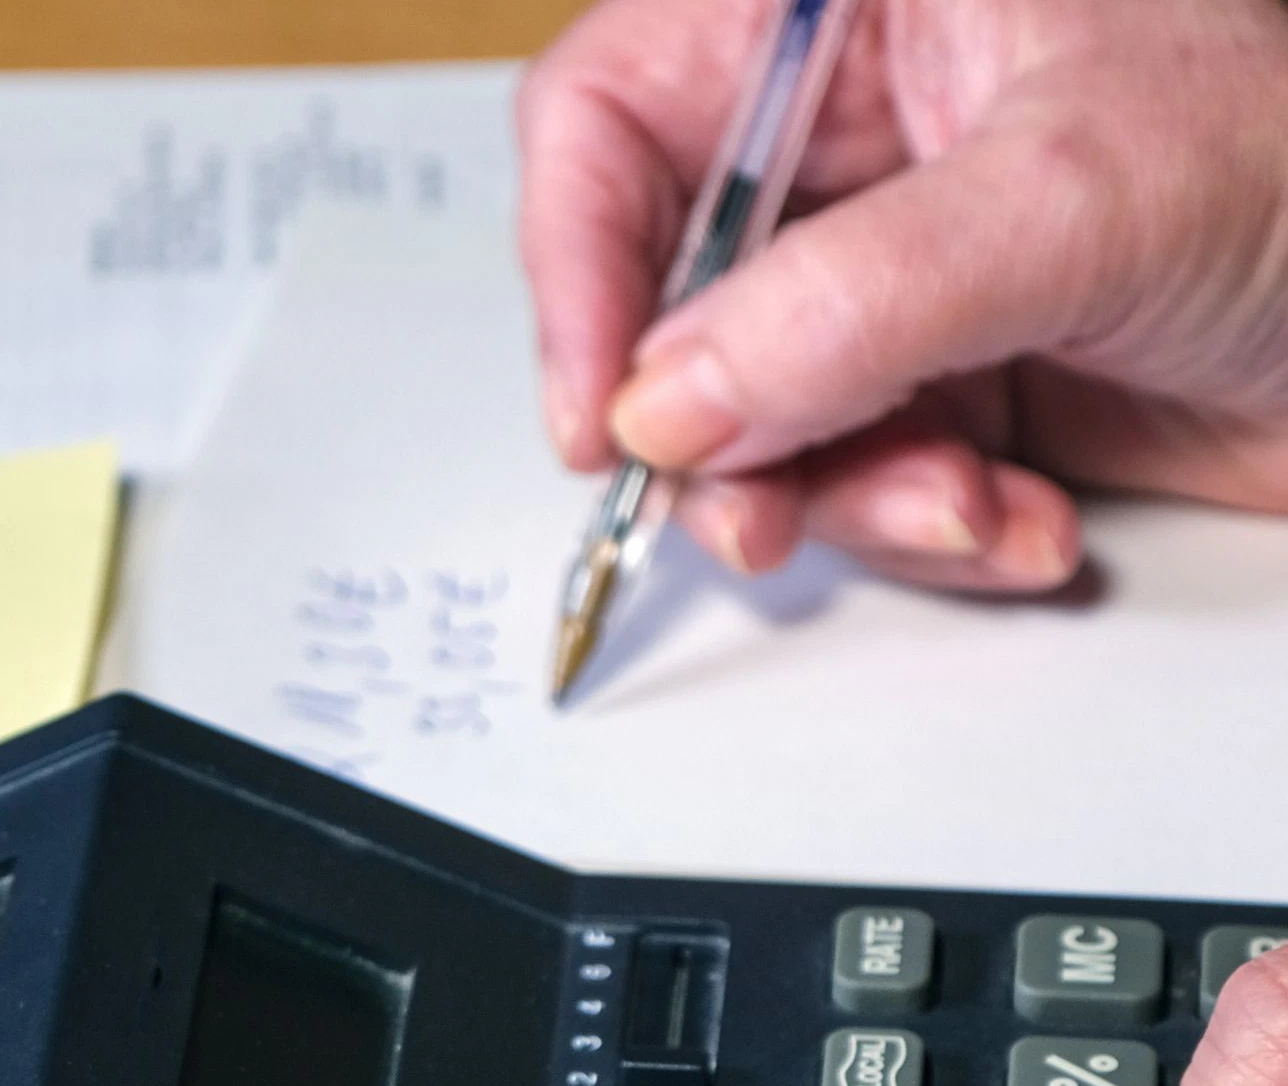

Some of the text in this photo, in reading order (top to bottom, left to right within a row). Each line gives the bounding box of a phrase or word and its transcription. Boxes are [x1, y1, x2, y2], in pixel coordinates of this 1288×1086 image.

[864, 916, 903, 975] RATE
[1061, 925, 1119, 983] MC
[570, 1035, 602, 1051] 3
[566, 1071, 598, 1086] 2
